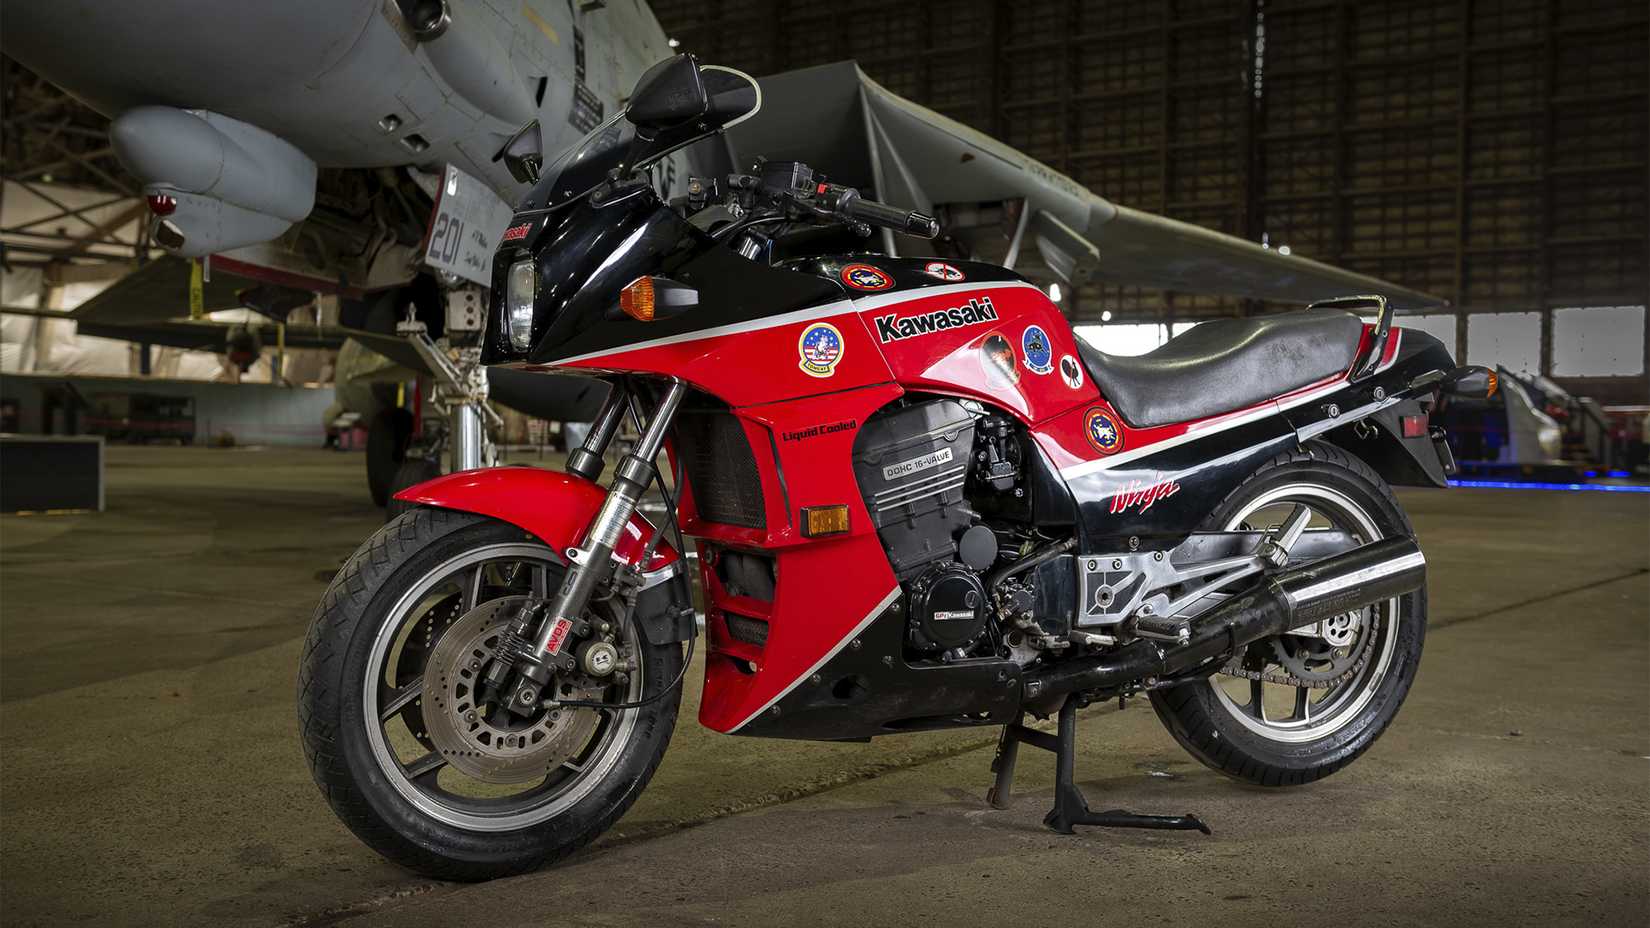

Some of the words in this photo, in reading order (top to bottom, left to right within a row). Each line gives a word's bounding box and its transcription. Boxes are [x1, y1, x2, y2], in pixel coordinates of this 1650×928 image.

[428, 211, 464, 265] 201
[875, 297, 998, 343] Kawasaki
[782, 426, 818, 441] Liquid
[819, 419, 856, 435] Cooled
[887, 463, 913, 477] DOHC
[914, 450, 950, 468] 16-VALVE
[1109, 471, 1180, 515] Ninja
